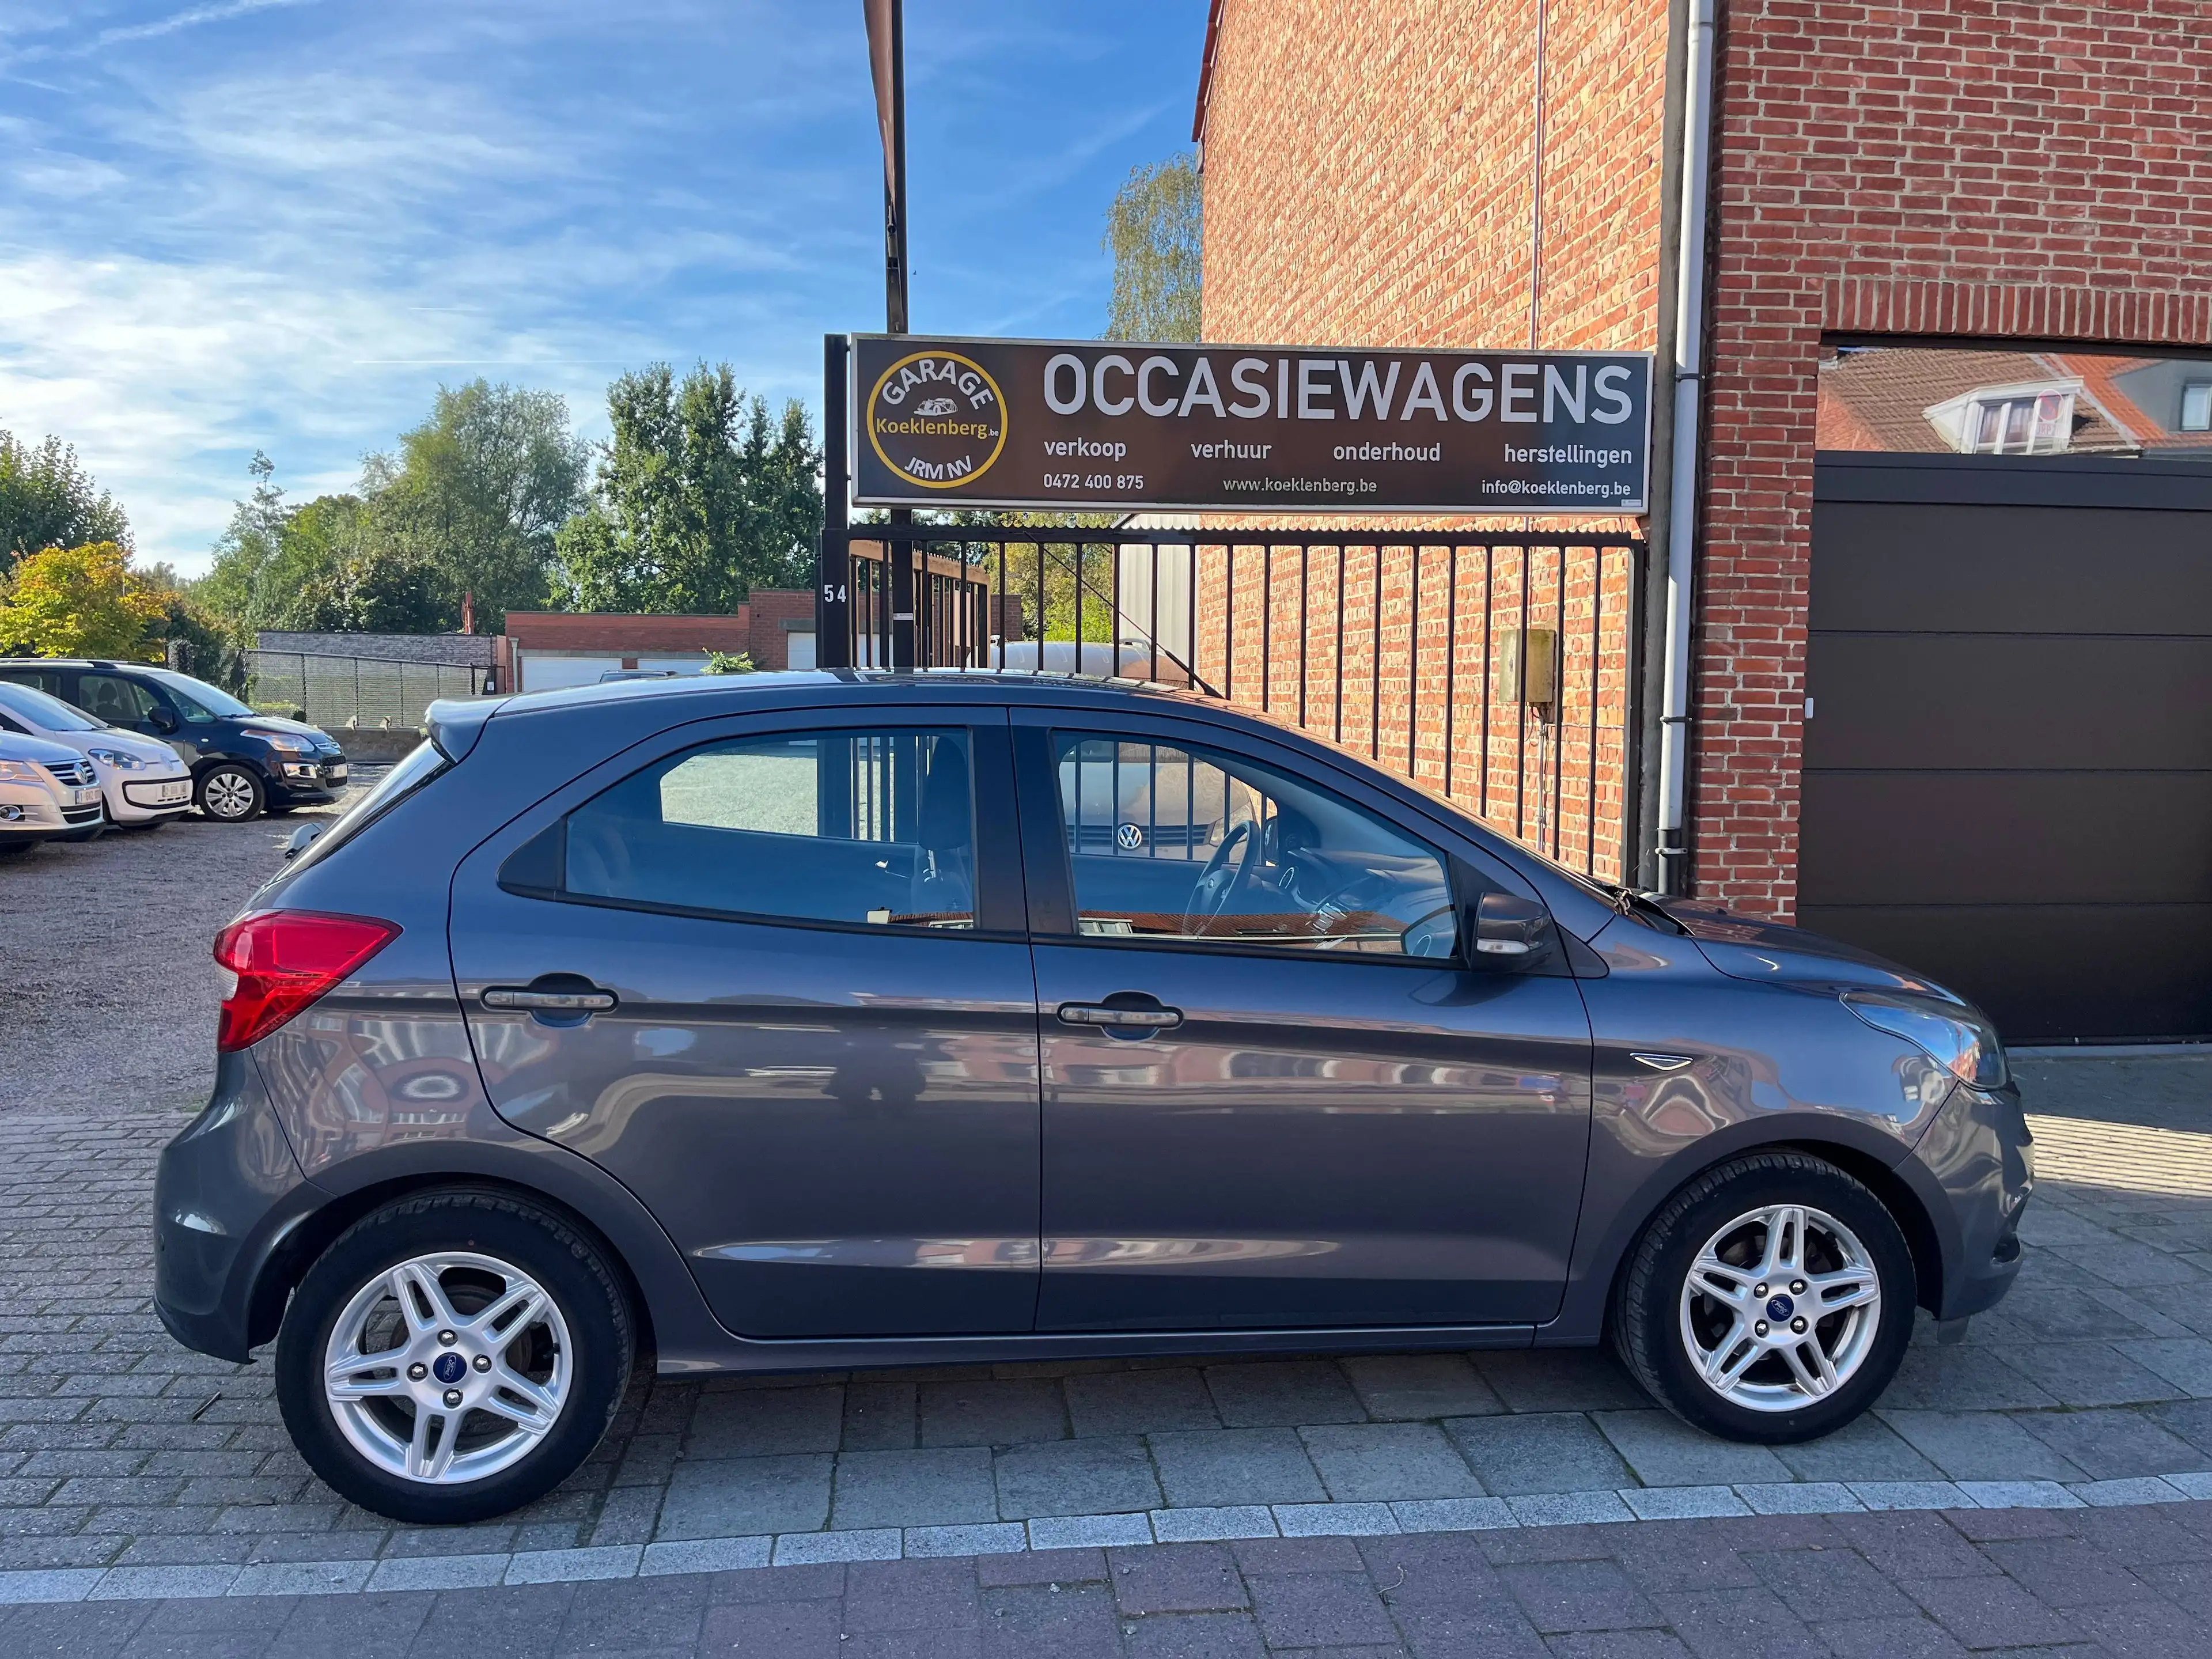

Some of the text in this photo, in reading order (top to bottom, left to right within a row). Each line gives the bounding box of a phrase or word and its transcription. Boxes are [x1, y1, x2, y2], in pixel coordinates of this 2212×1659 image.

[882, 359, 994, 410] GARAGE
[1044, 353, 1633, 425] OCCASIEWAGENS
[1044, 437, 1126, 461] verkoop
[1190, 440, 1272, 459] verhuur
[1334, 441, 1441, 461] onderhoud
[1505, 444, 1633, 469] herstellingen
[904, 454, 972, 480] JRM NV
[1043, 474, 1143, 490] 0472 400 875
[1223, 477, 1377, 495] www.koeklenberg.be
[1482, 479, 1631, 498] info@koeklenberg.be
[824, 584, 847, 603] 54
